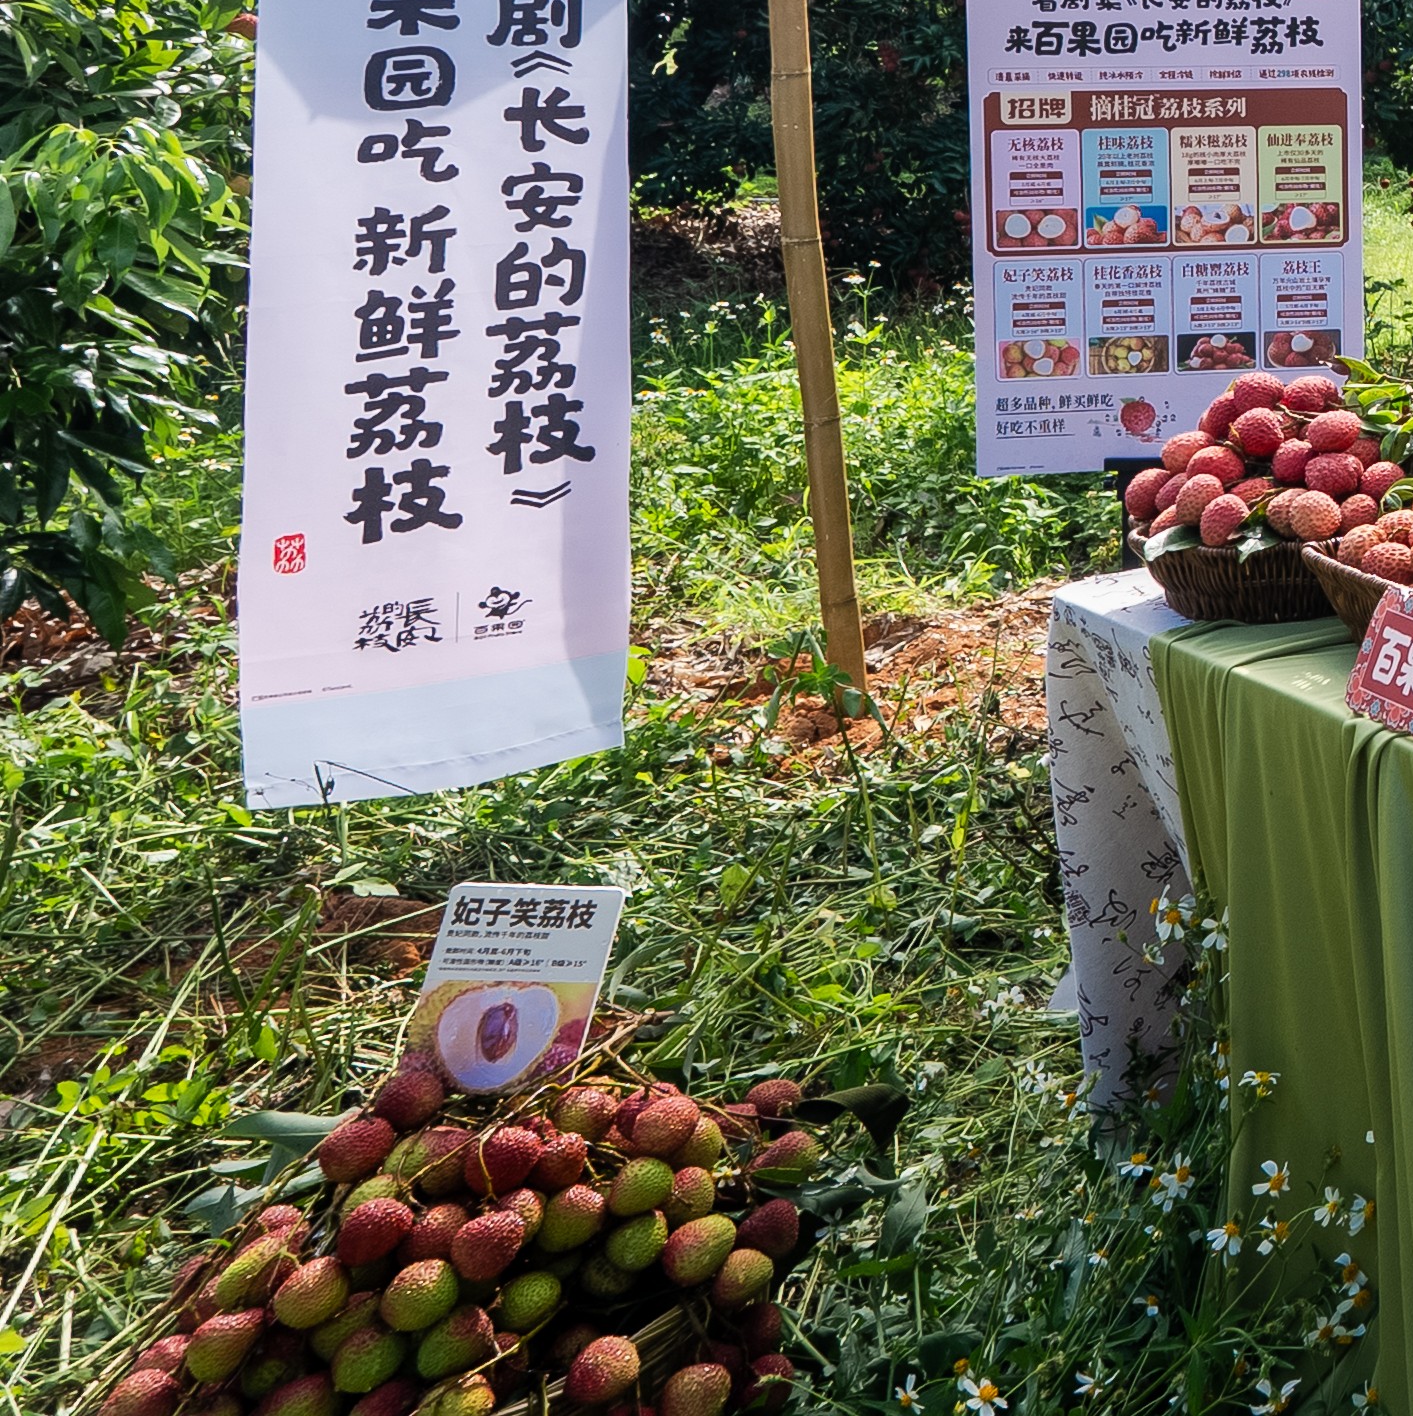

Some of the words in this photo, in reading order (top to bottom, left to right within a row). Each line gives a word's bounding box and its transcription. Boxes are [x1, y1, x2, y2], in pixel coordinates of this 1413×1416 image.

[1004, 16, 1324, 57] 来百果园吃新鲜荔枝
[1007, 97, 1066, 119] 招牌
[1008, 136, 1064, 152] 无核荔枝
[1098, 135, 1154, 151] 桂味荔枝
[1179, 134, 1248, 149] 糯米糍荔枝
[1266, 133, 1334, 148] 仙进奉荔枝
[1094, 264, 1162, 281] 桂花香荔枝
[1281, 259, 1322, 275] 荔枝王
[1003, 268, 1074, 283] 妃子笑荔枝
[996, 418, 1066, 436] 好吃不重样
[450, 895, 598, 930] 妃子笑荔枝
